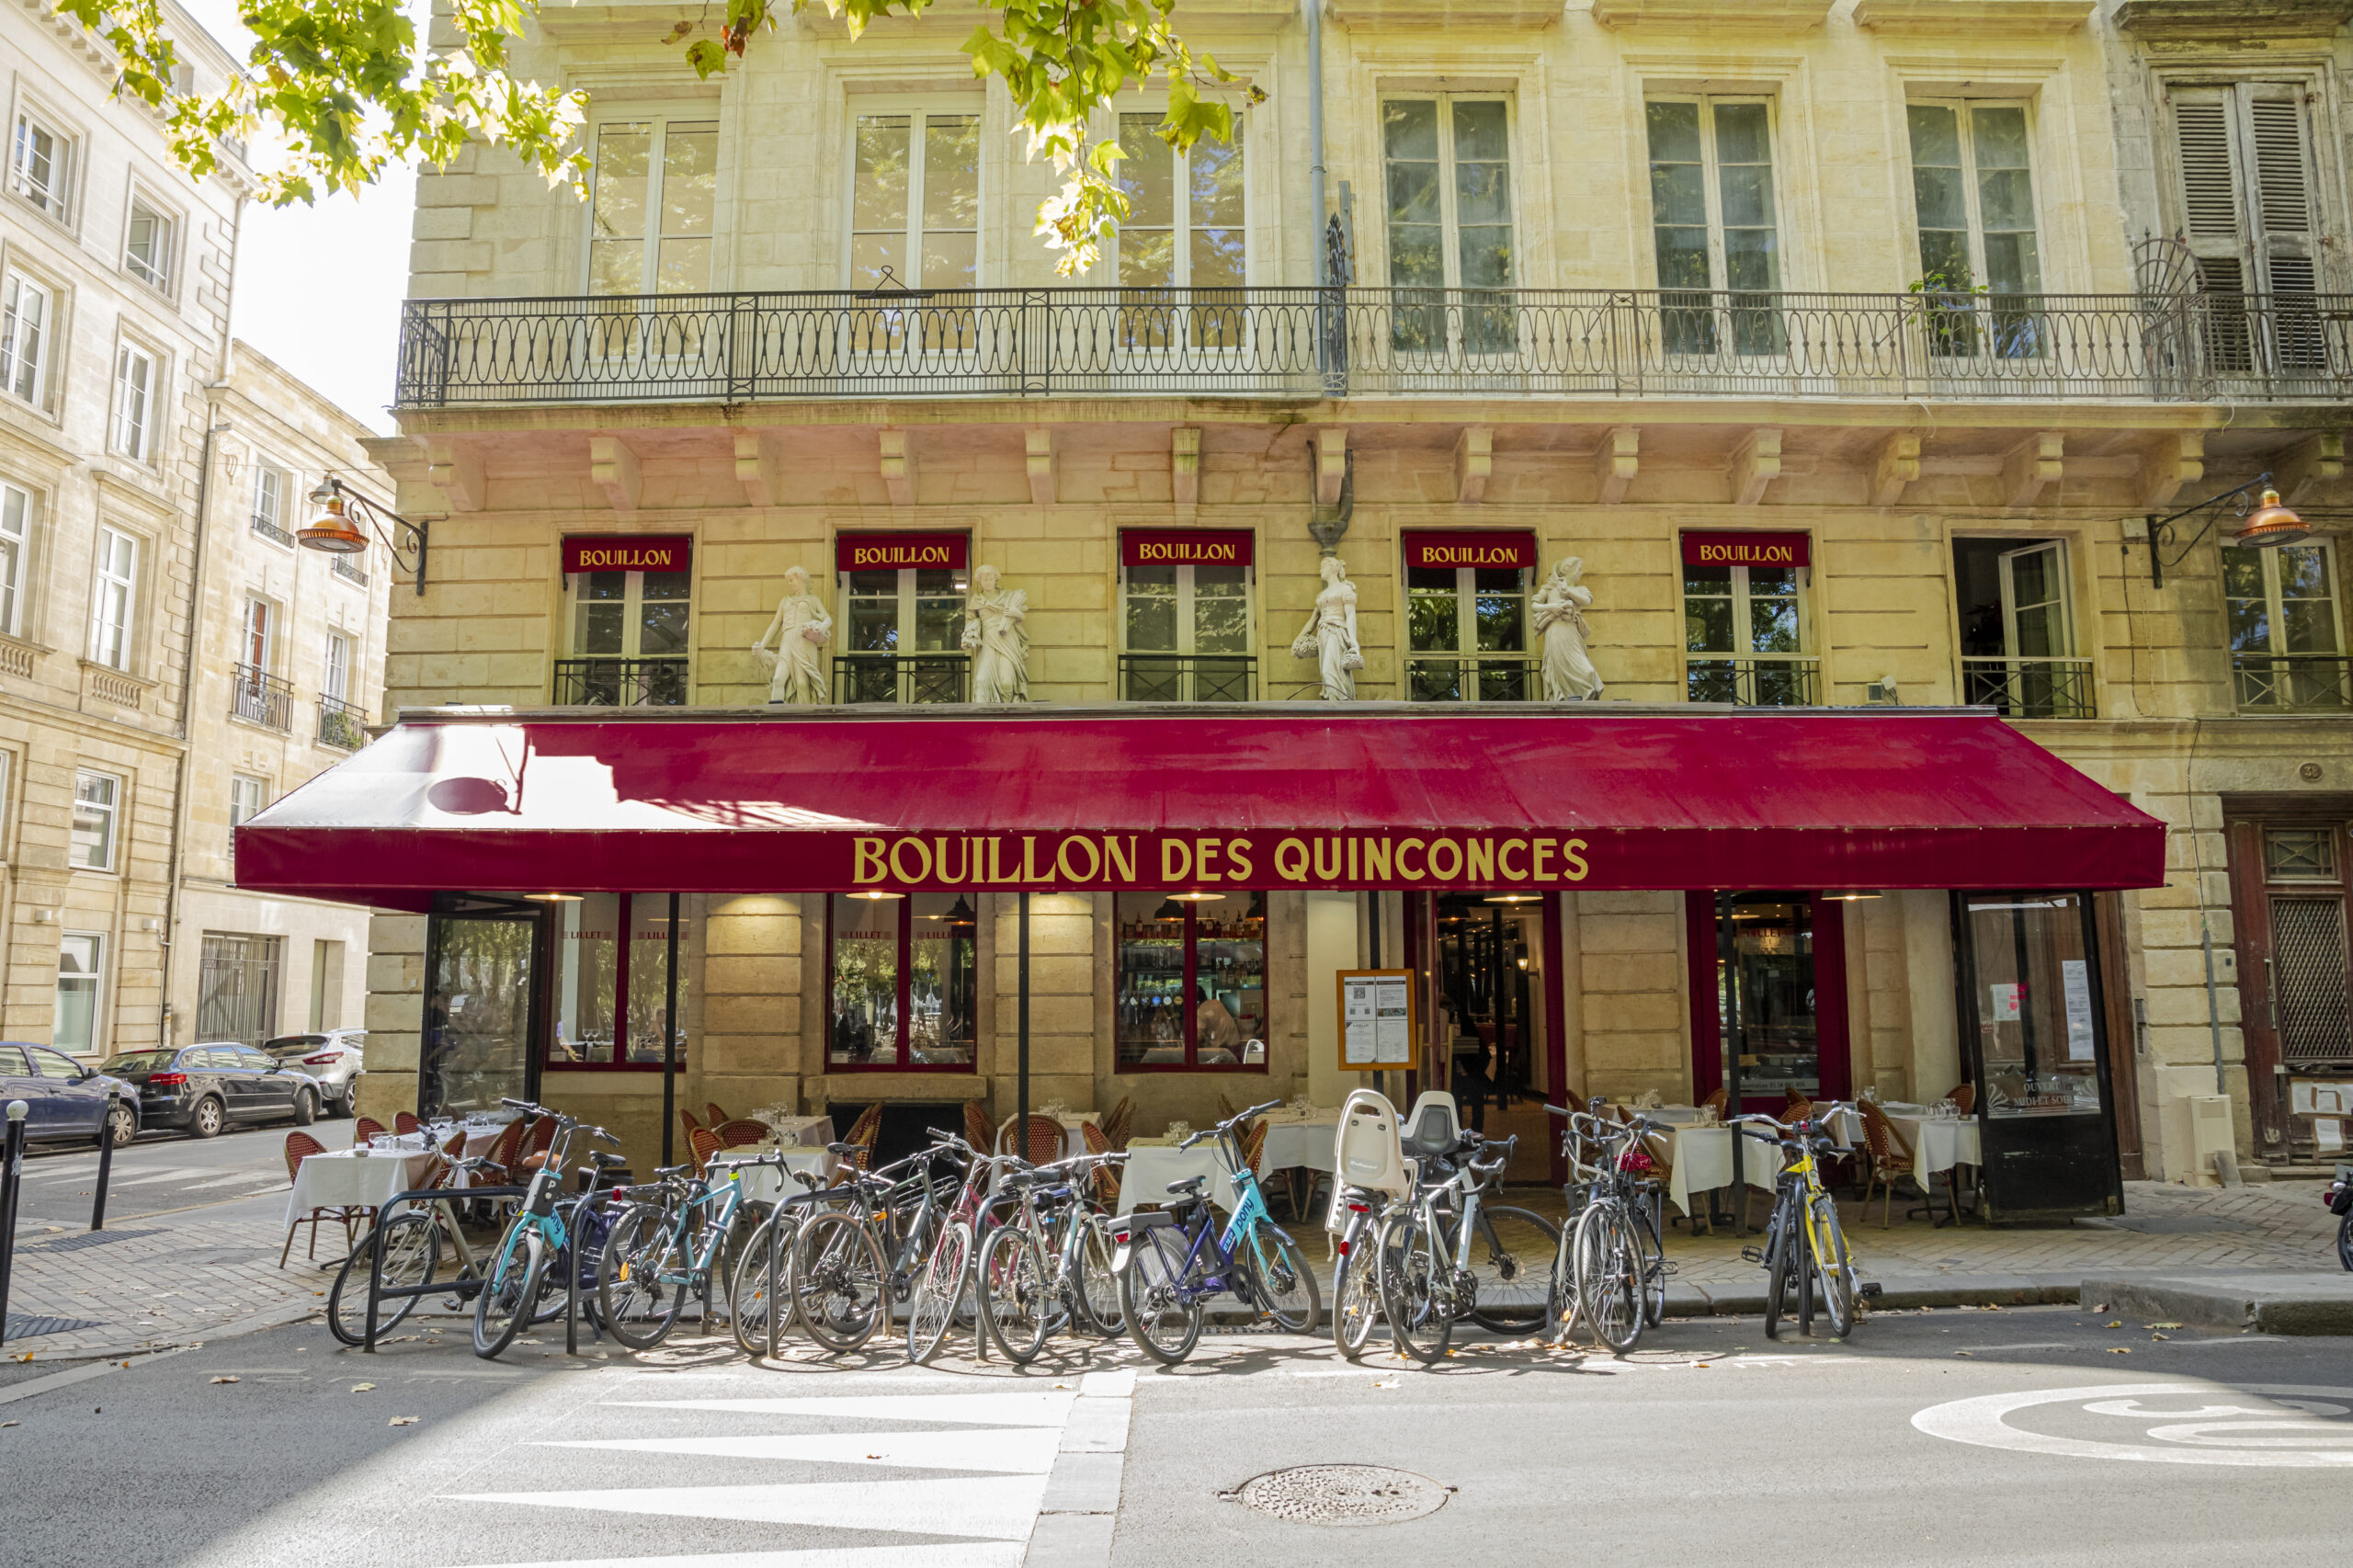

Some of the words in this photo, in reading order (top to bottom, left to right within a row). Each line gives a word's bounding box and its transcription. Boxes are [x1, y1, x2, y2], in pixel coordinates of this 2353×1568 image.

[581, 550, 671, 566] BOUILLON
[855, 546, 949, 563] BOUILLON
[1140, 544, 1235, 560] BOUILLON
[1423, 546, 1518, 562] BOUILLON
[1700, 545, 1792, 561] BOUILLON
[853, 835, 1138, 884] BOUILLON
[1162, 837, 1253, 882] DES
[1275, 837, 1589, 882] QUINCONCES
[571, 931, 603, 939] LILLET
[647, 931, 670, 939] LILL
[849, 931, 882, 939] LILLET
[2023, 1082, 2060, 1092] OUVERT
[2051, 1095, 2074, 1105] SOIR
[551, 1210, 563, 1234] ony
[1235, 1198, 1255, 1232] pony
